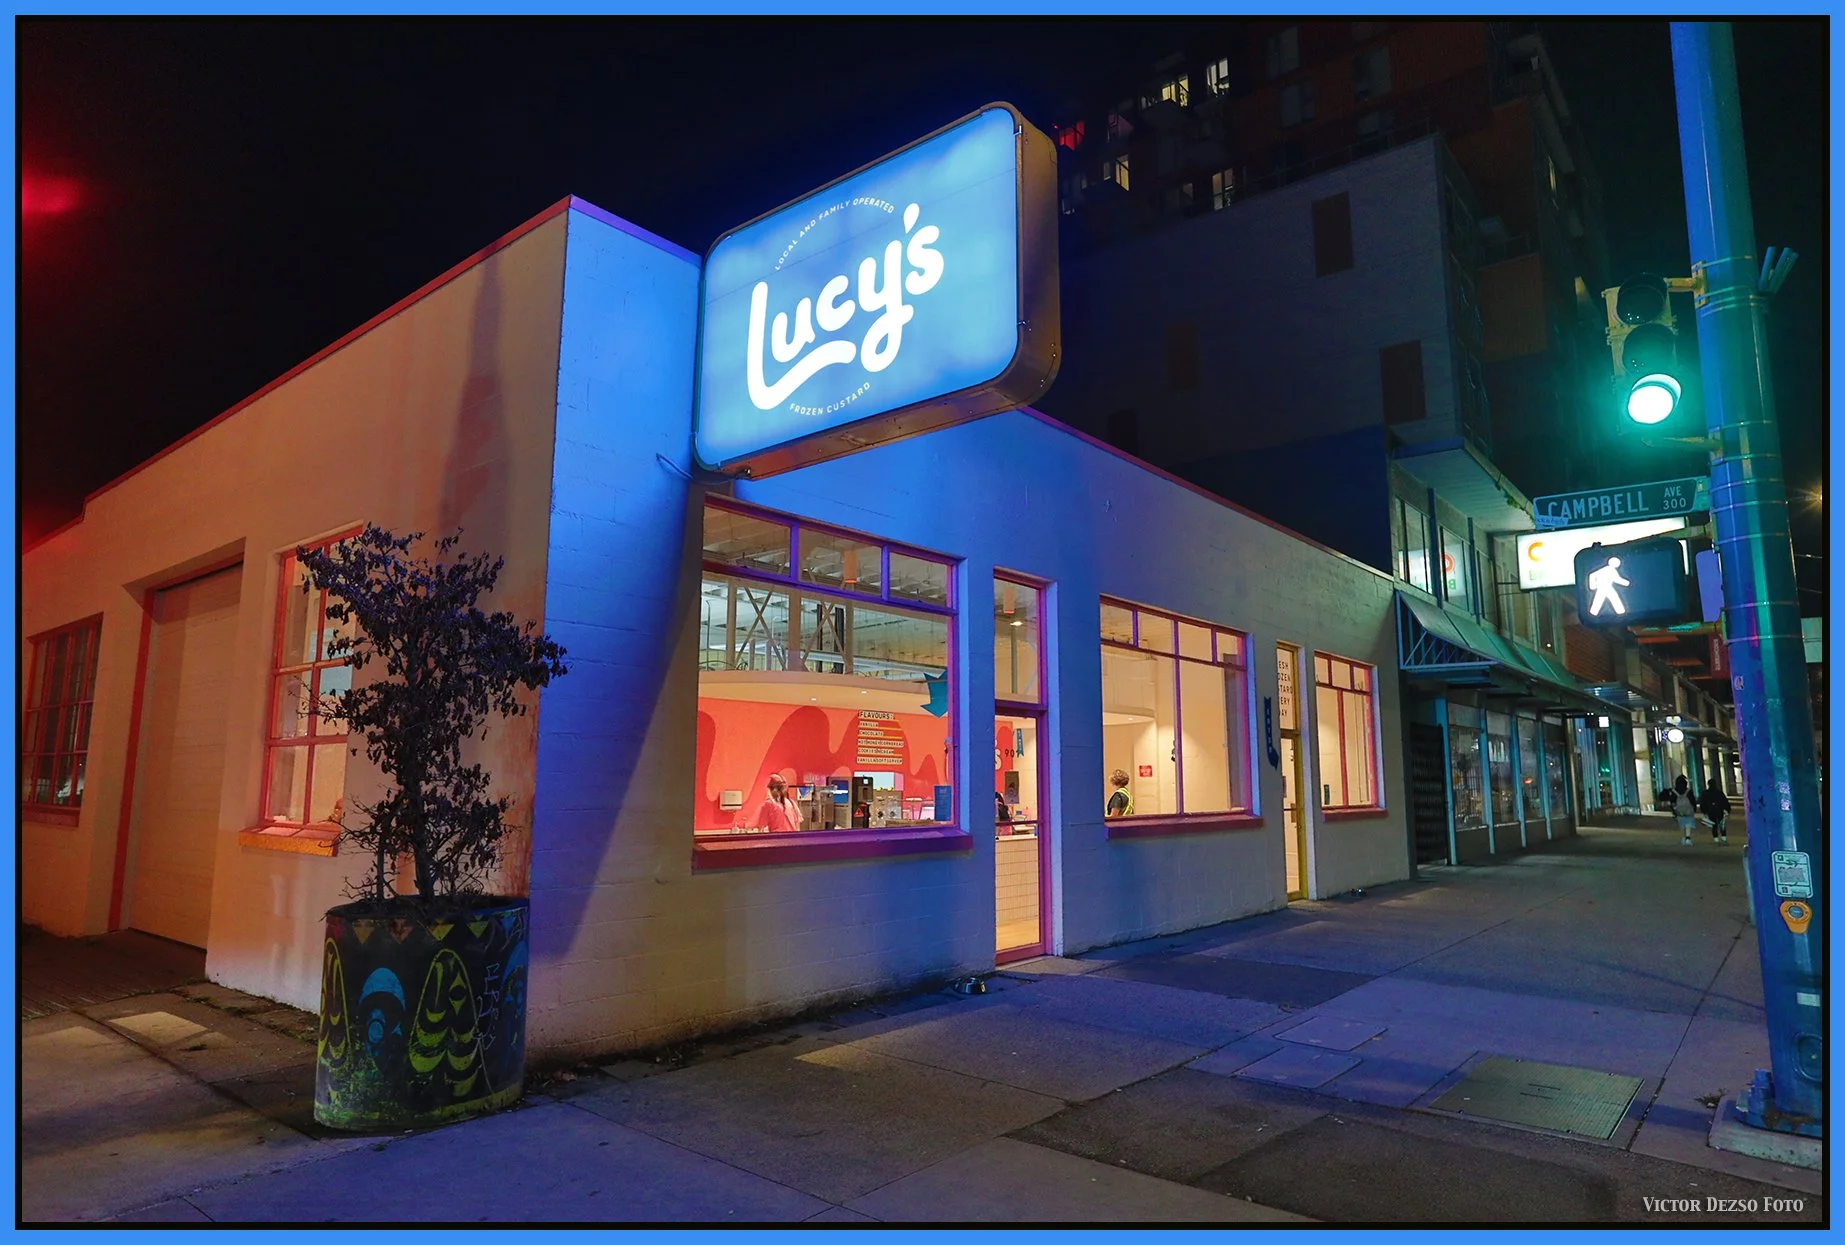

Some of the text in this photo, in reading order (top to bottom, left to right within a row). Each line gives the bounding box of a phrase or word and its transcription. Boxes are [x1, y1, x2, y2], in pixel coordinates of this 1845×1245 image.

[775, 197, 895, 270] LOCAL AND FAMILY OPERATED
[747, 202, 945, 410] Lucy's
[789, 382, 871, 416] FROZEN CUSTARD
[1547, 485, 1682, 520] CAMPBELL AVE
[1663, 498, 1687, 510] 300
